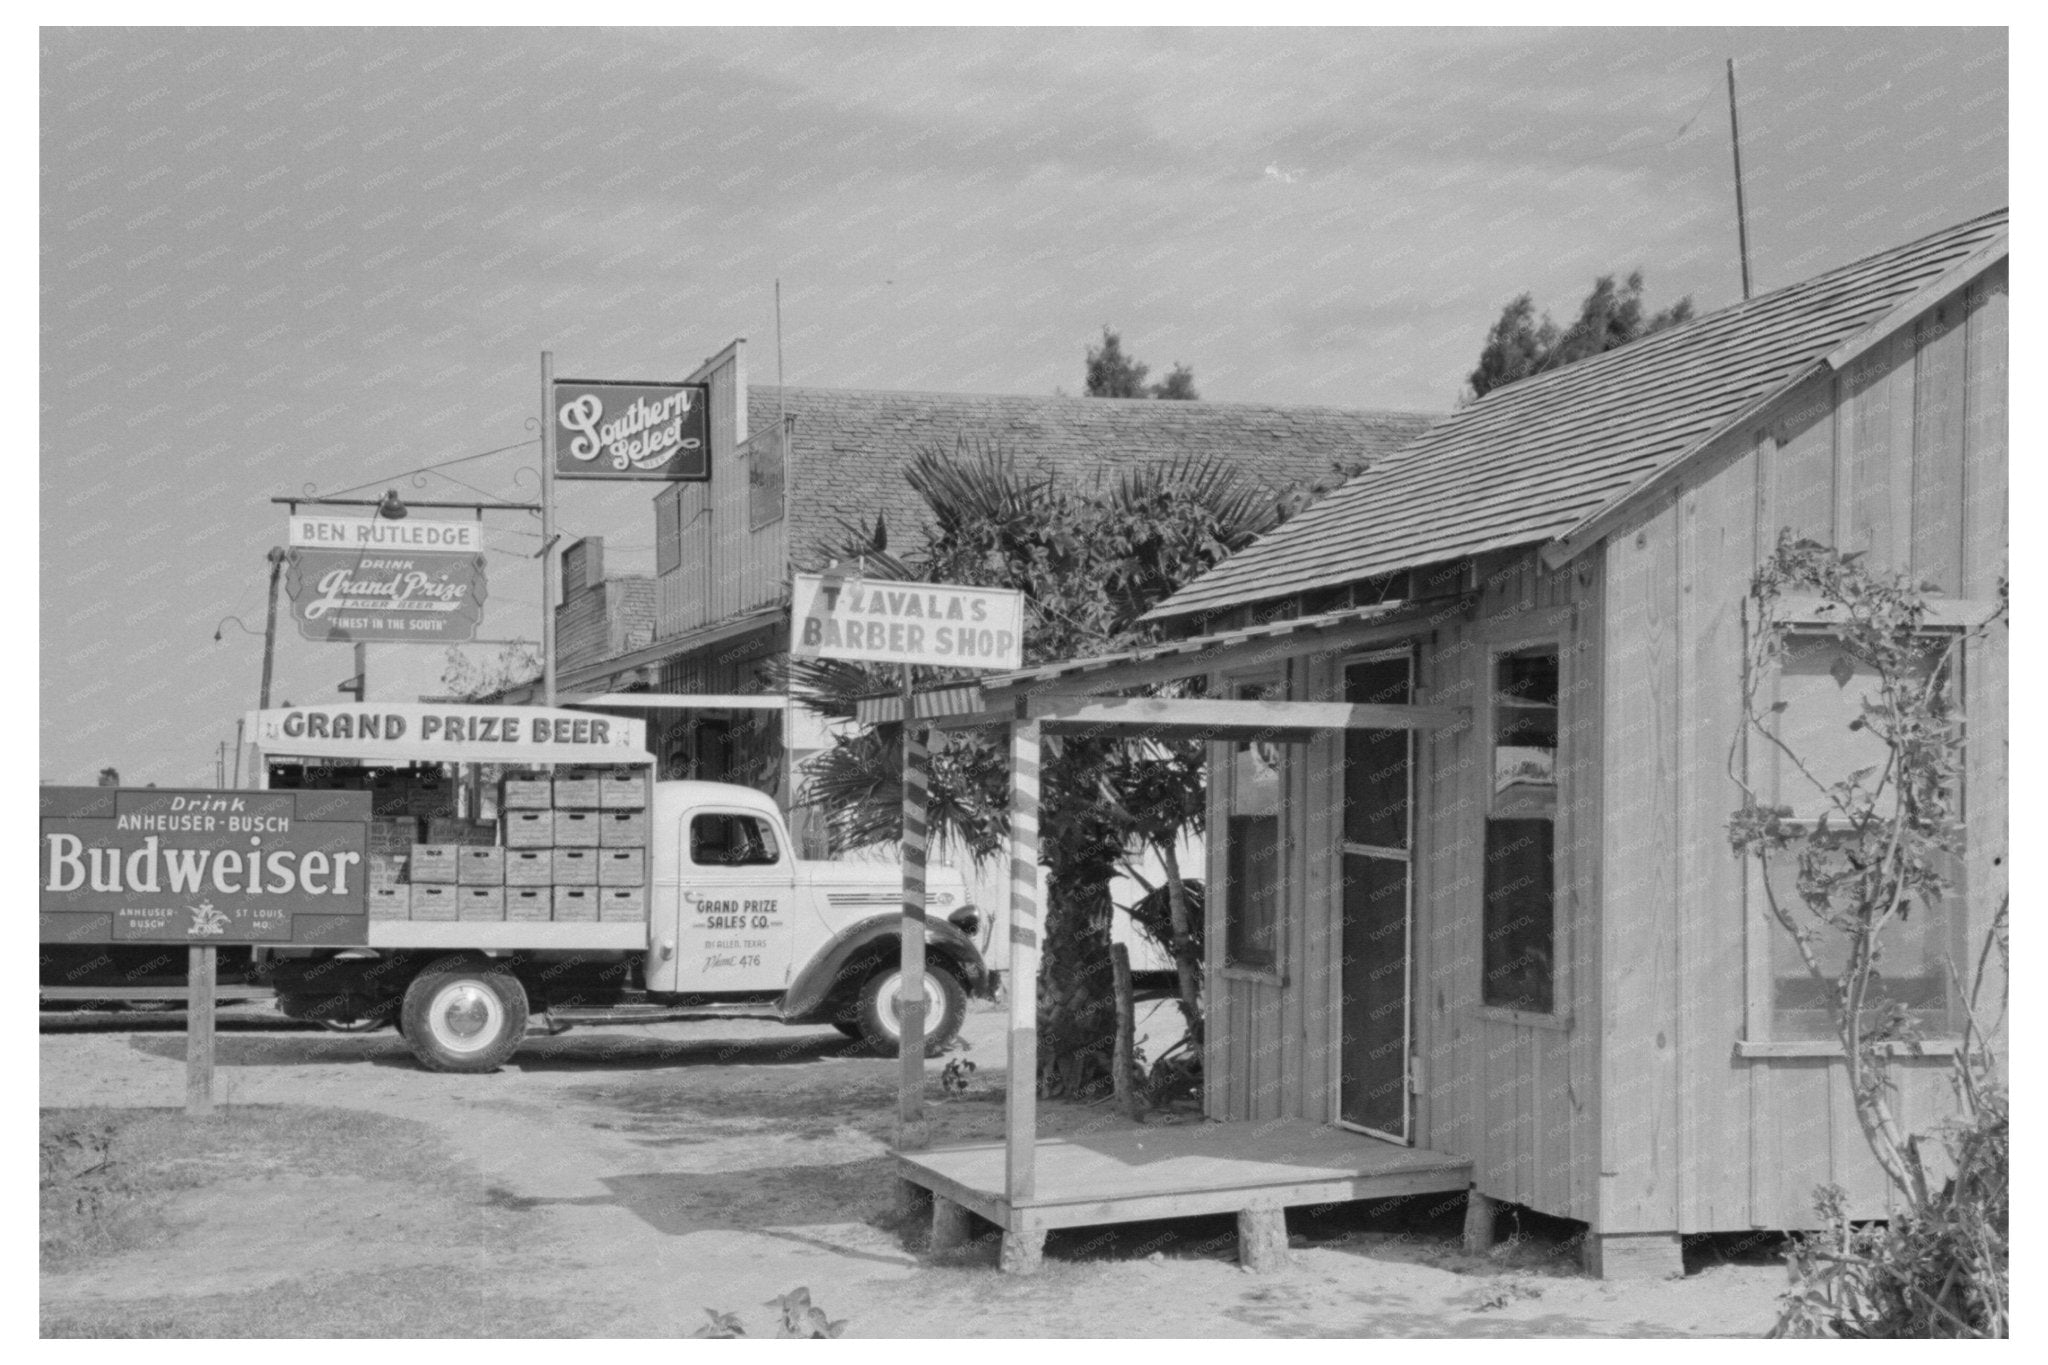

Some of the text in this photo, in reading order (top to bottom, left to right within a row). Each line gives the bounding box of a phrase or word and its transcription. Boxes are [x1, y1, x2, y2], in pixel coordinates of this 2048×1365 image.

[559, 389, 692, 461] Southern
[609, 416, 683, 470] Select
[303, 523, 470, 545] BEN RUTLEDGE
[360, 559, 415, 570] DRINK
[314, 569, 468, 605] Grand Prize
[372, 618, 384, 629] IN
[387, 619, 405, 630] THE
[803, 616, 1015, 659] BARBER SHOP
[283, 711, 612, 745] GRAND PRIZE BEER
[170, 795, 245, 812] Drink
[117, 814, 289, 833] ANHEUSER-BUSCH
[45, 832, 360, 895] Budweiser
[235, 908, 249, 918] ST
[696, 900, 778, 914] GRAND PRIZE
[130, 919, 165, 929] BUSCH
[707, 915, 769, 929] SALES CO.
[743, 940, 767, 948] TEXAS
[739, 954, 761, 968] 476
